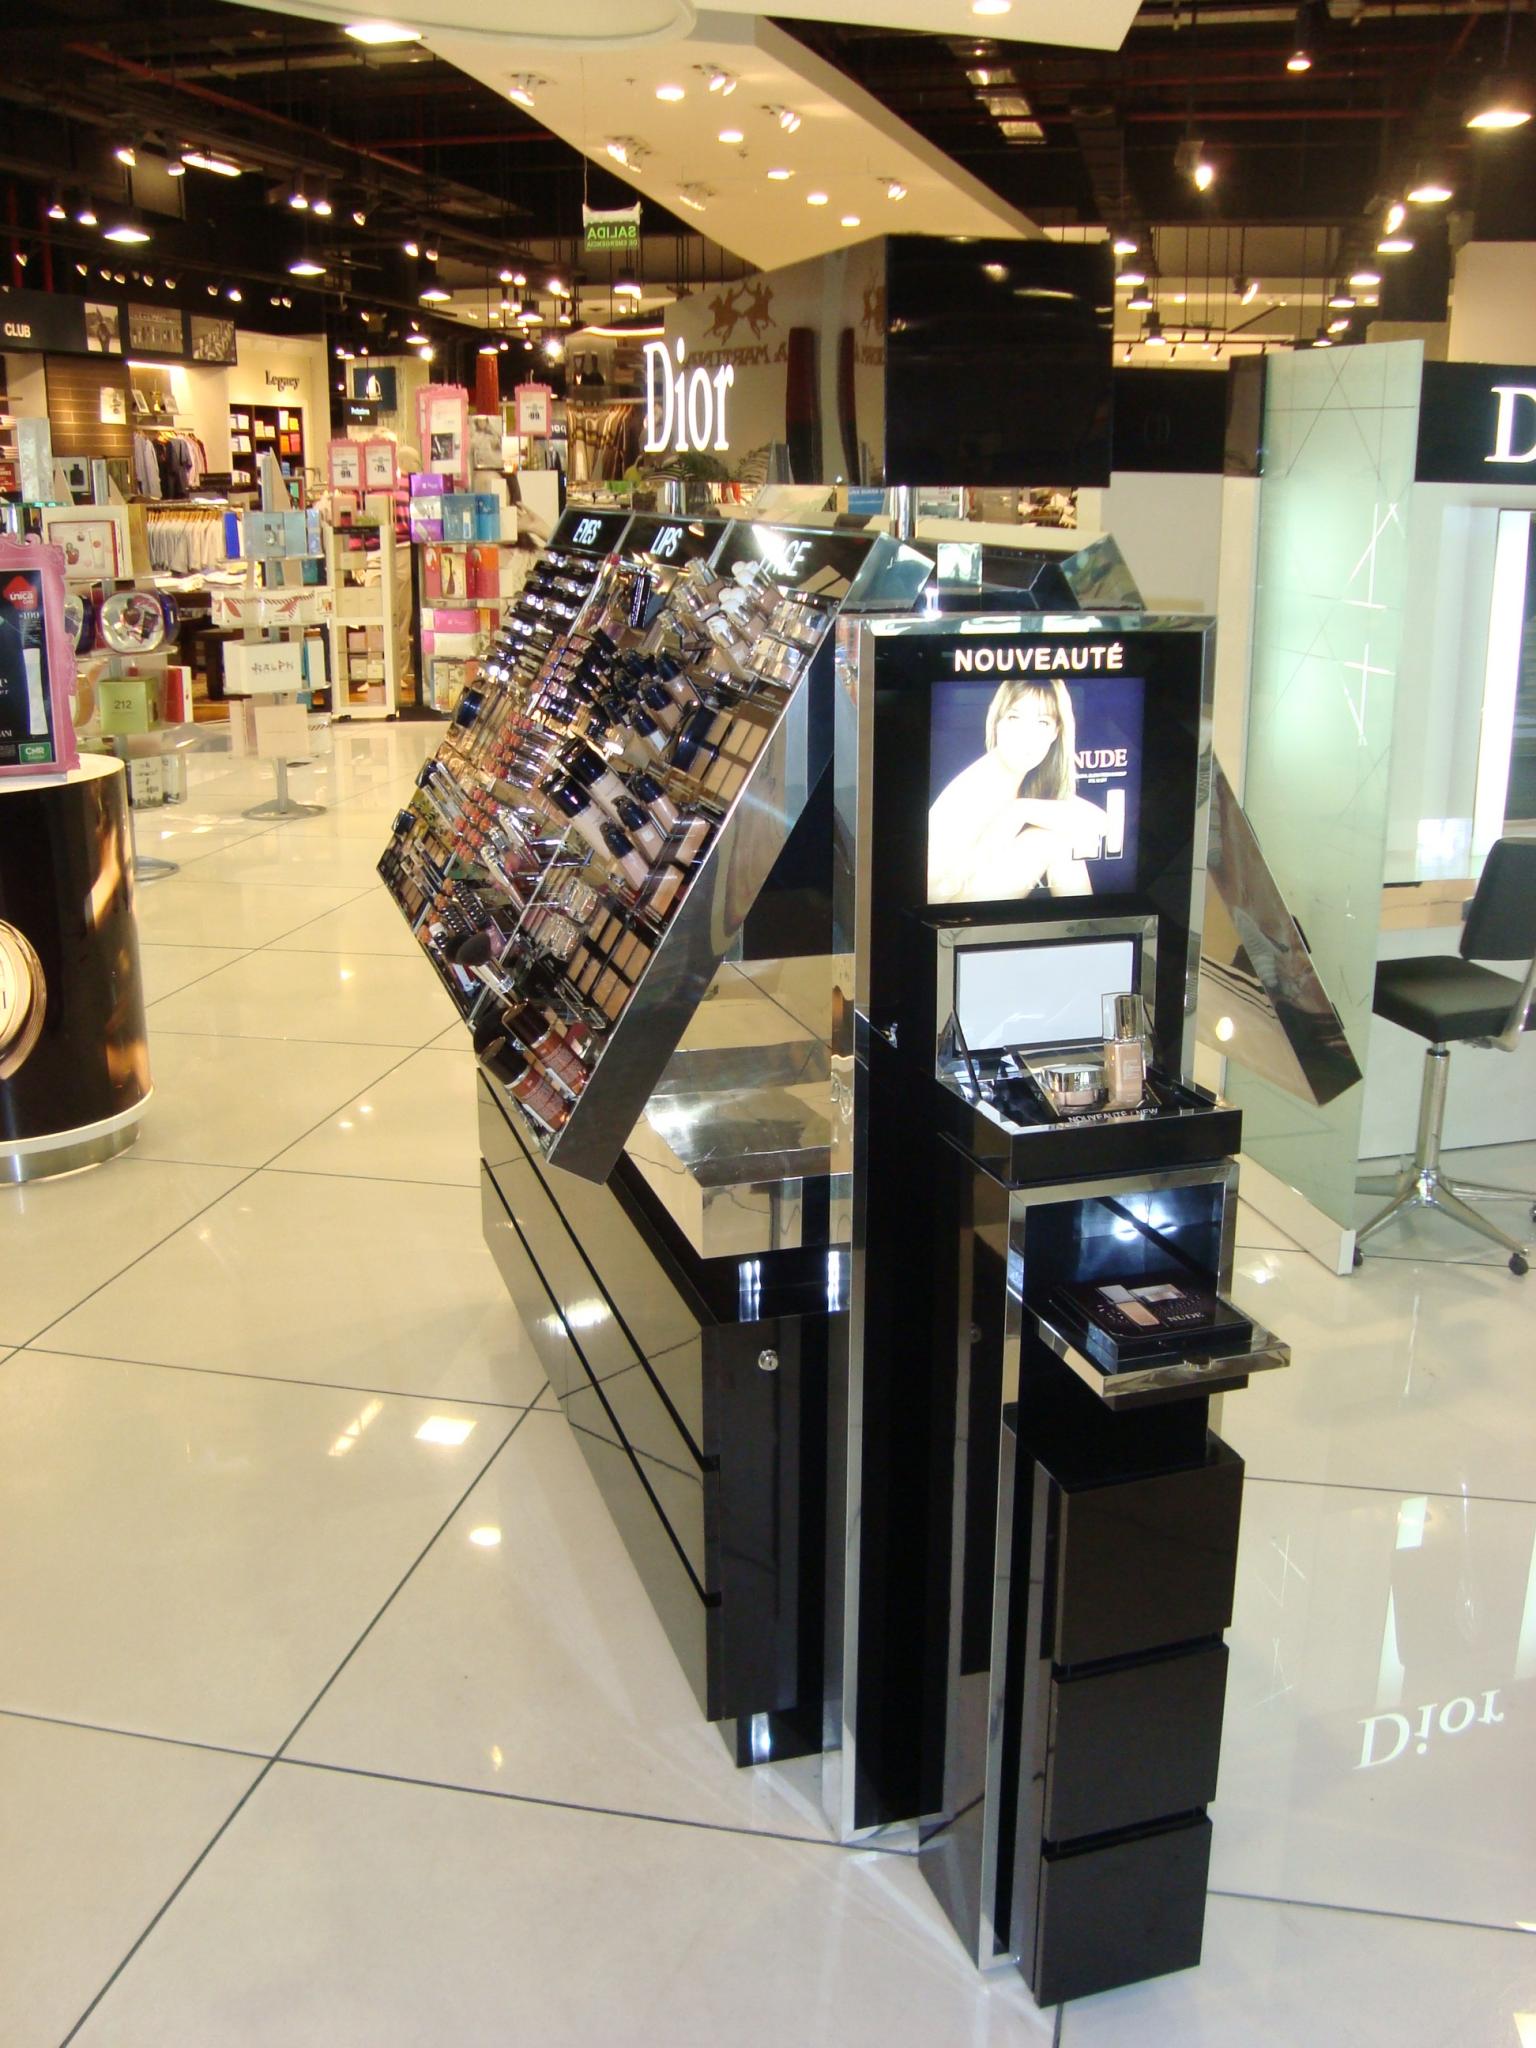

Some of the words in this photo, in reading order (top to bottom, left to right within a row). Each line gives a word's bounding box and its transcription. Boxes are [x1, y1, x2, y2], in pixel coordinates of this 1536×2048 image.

[4, 323, 31, 338] CLUB
[643, 337, 735, 452] Dior
[572, 518, 602, 545] EYES
[651, 526, 684, 557] LIPS
[954, 643, 1124, 672] NOUVEAUTÉ
[114, 699, 132, 710] 212
